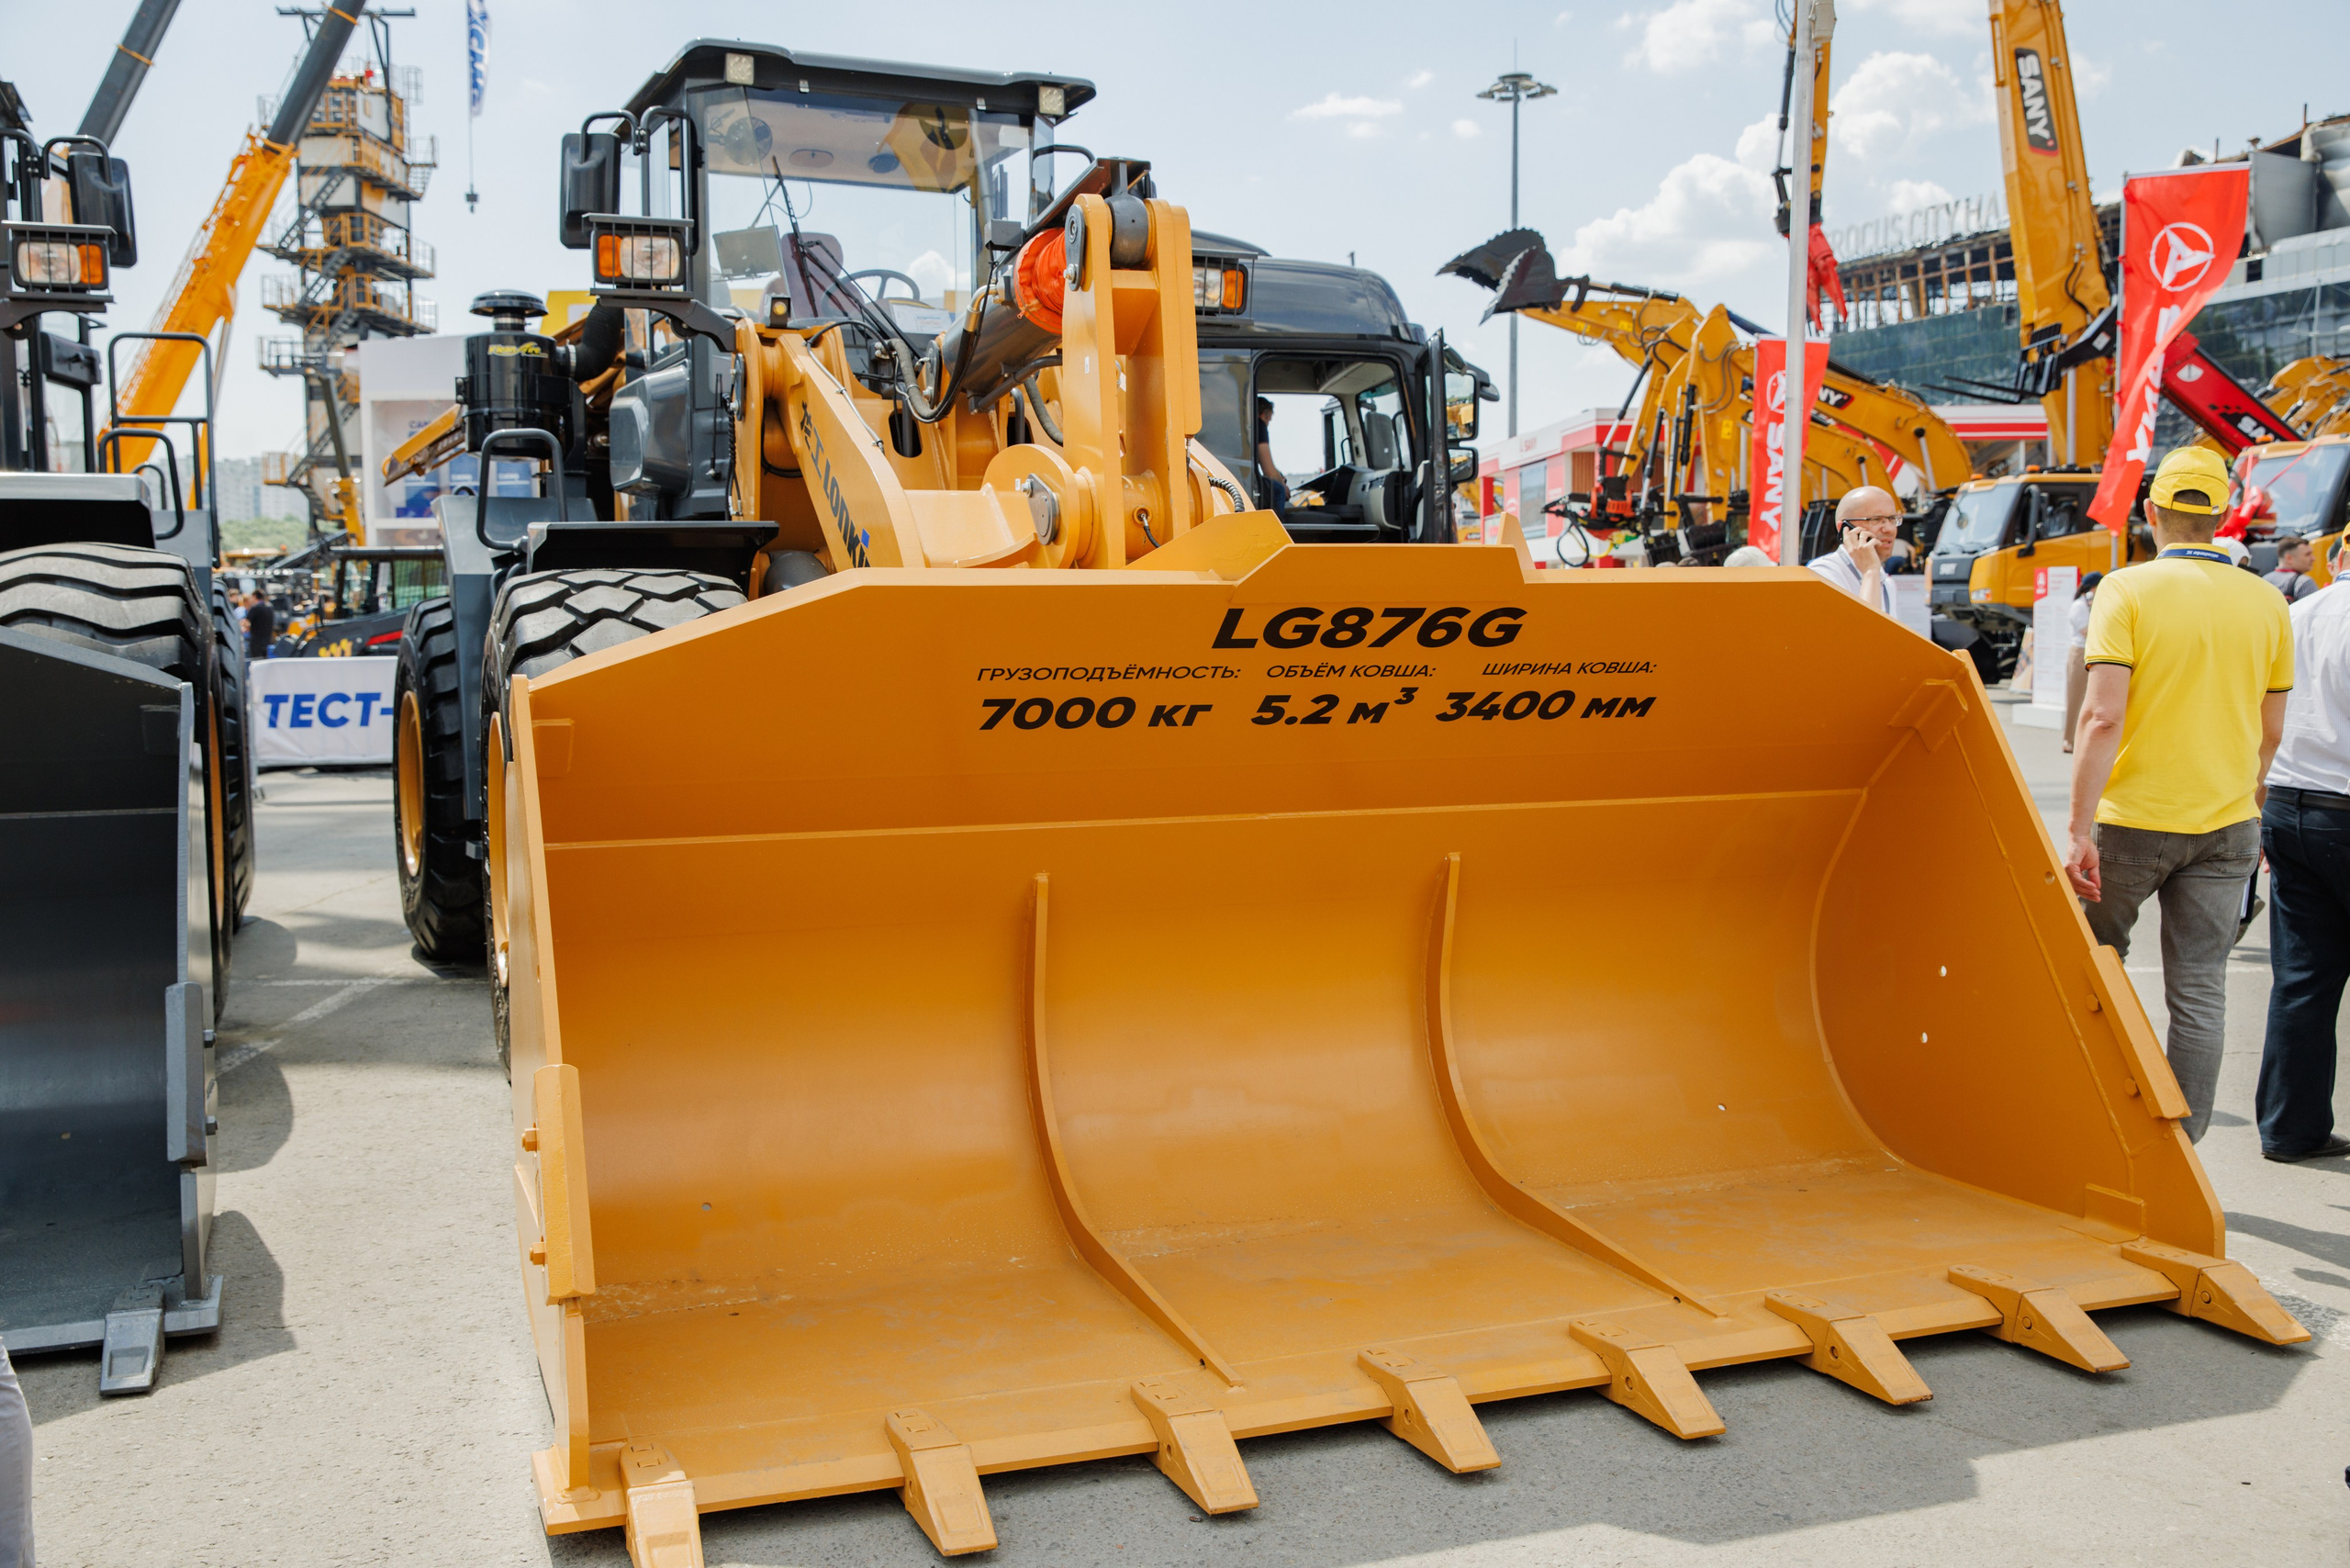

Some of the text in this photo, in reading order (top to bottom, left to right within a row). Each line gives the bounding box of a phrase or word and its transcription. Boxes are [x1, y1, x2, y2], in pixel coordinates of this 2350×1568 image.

[2017, 53, 2052, 140] SANY
[1826, 189, 2001, 255] ROCUS CITY HA
[1818, 386, 1843, 407] NY
[1759, 421, 1786, 532] SANY
[1211, 606, 1528, 650] LG876G
[977, 664, 1241, 682] ГРУЗОПОДЪЁМНОСТЬ:
[1266, 663, 1437, 679] ОБЪЁМ КОВША:
[1482, 661, 1657, 676] ШИРИНА КОВША:
[979, 696, 1136, 731] 7000
[1250, 694, 1340, 726] 5.2
[1435, 689, 1576, 722] 3400
